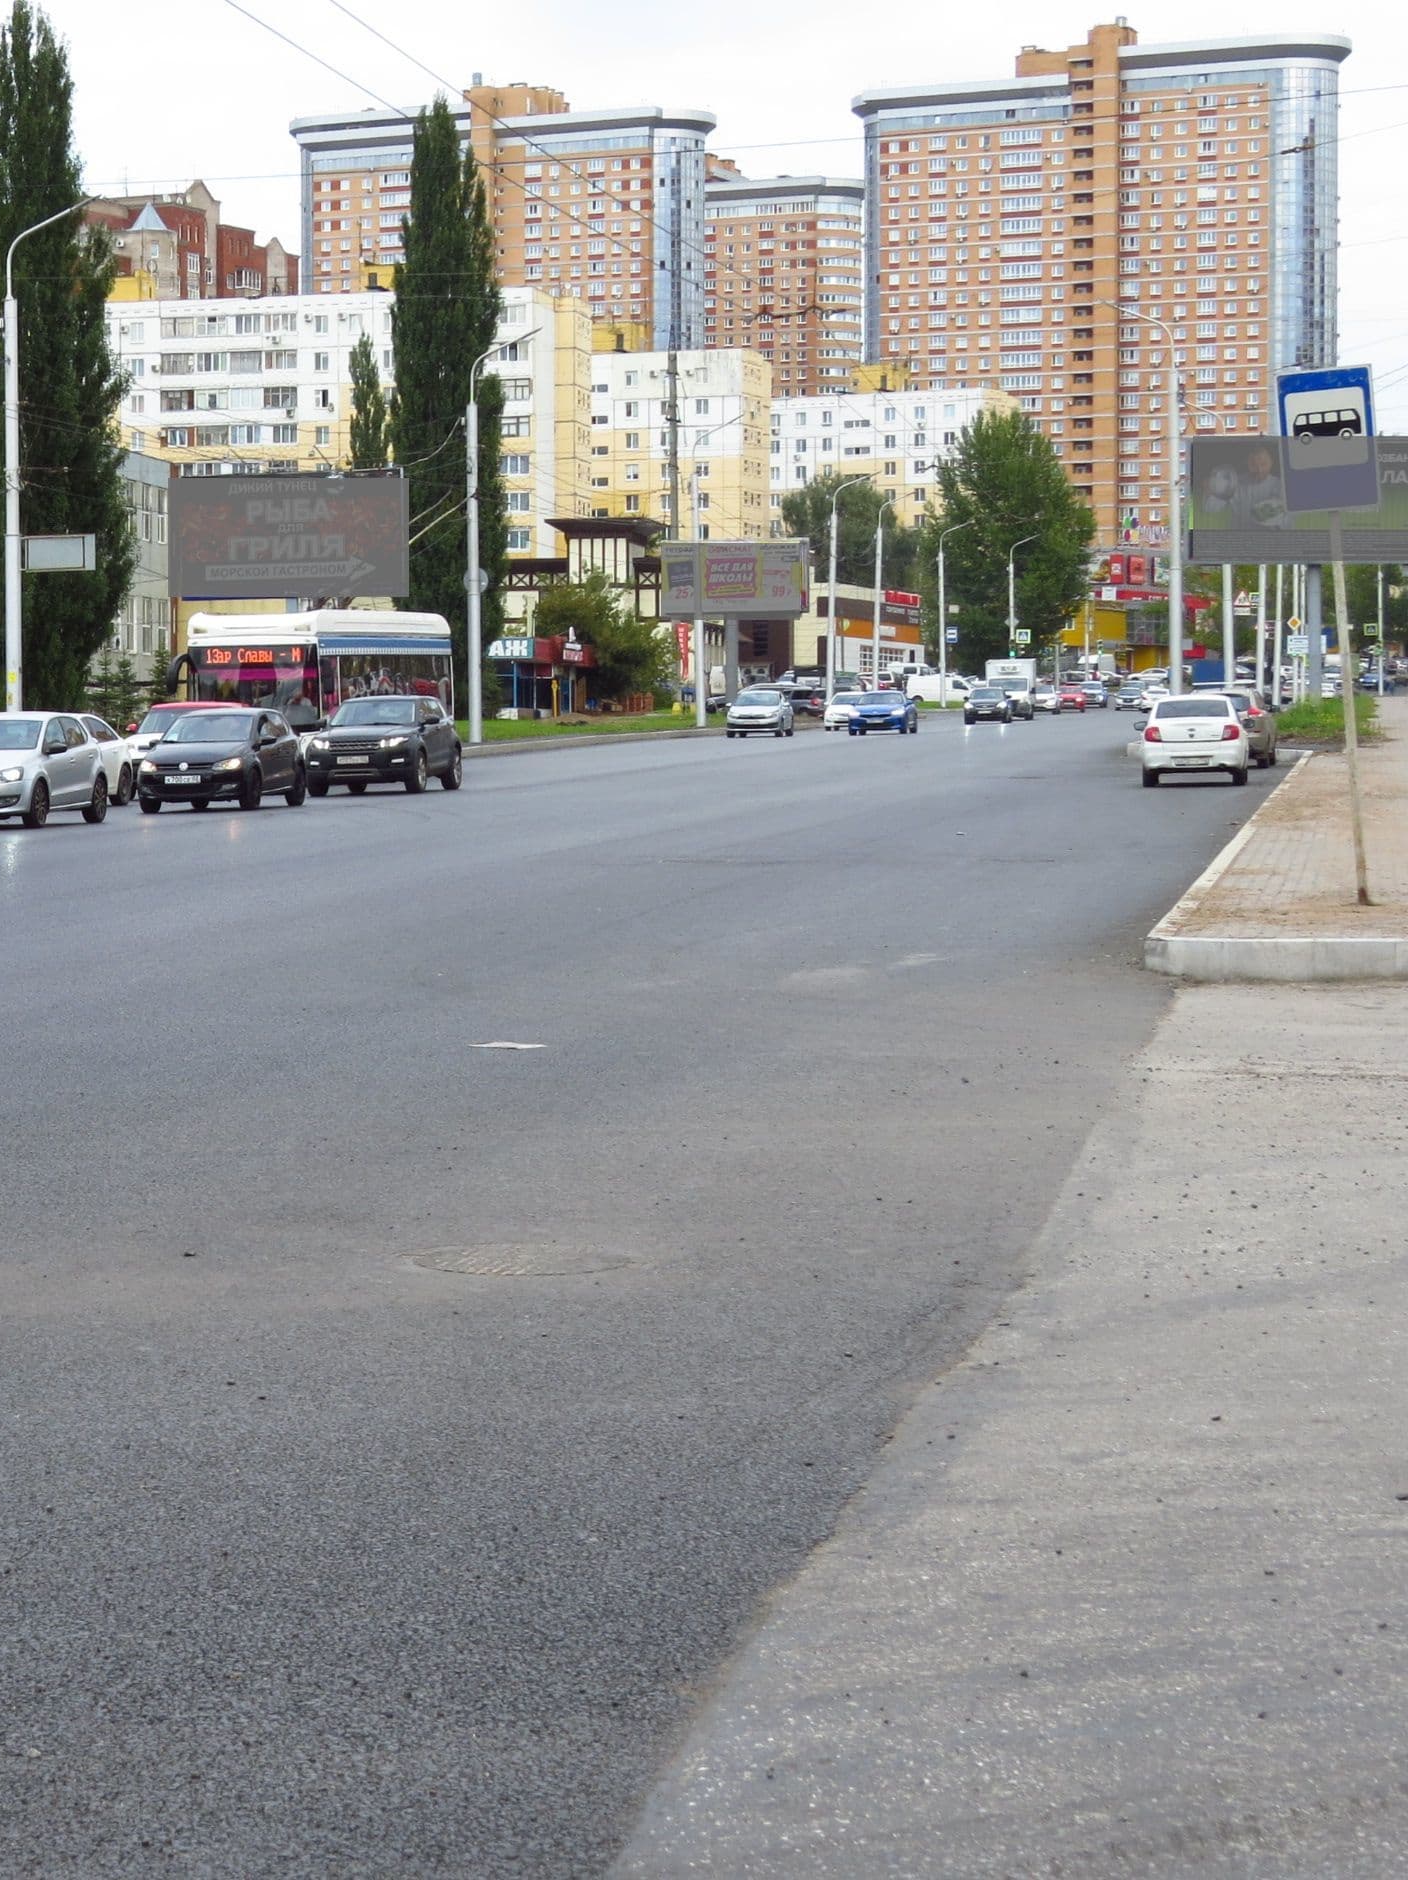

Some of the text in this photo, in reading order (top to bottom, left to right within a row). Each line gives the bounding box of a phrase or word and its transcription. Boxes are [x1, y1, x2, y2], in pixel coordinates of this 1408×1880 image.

[229, 479, 318, 496] ДИКИЙ ТУНЕЦ
[246, 497, 332, 524] РЫБА
[228, 533, 346, 561] ГРИЛЯ
[210, 564, 347, 578] МОРСКОЙ ГАСТРОНОМ
[709, 573, 753, 583] ШКОЛЫ
[237, 647, 273, 663] Славы
